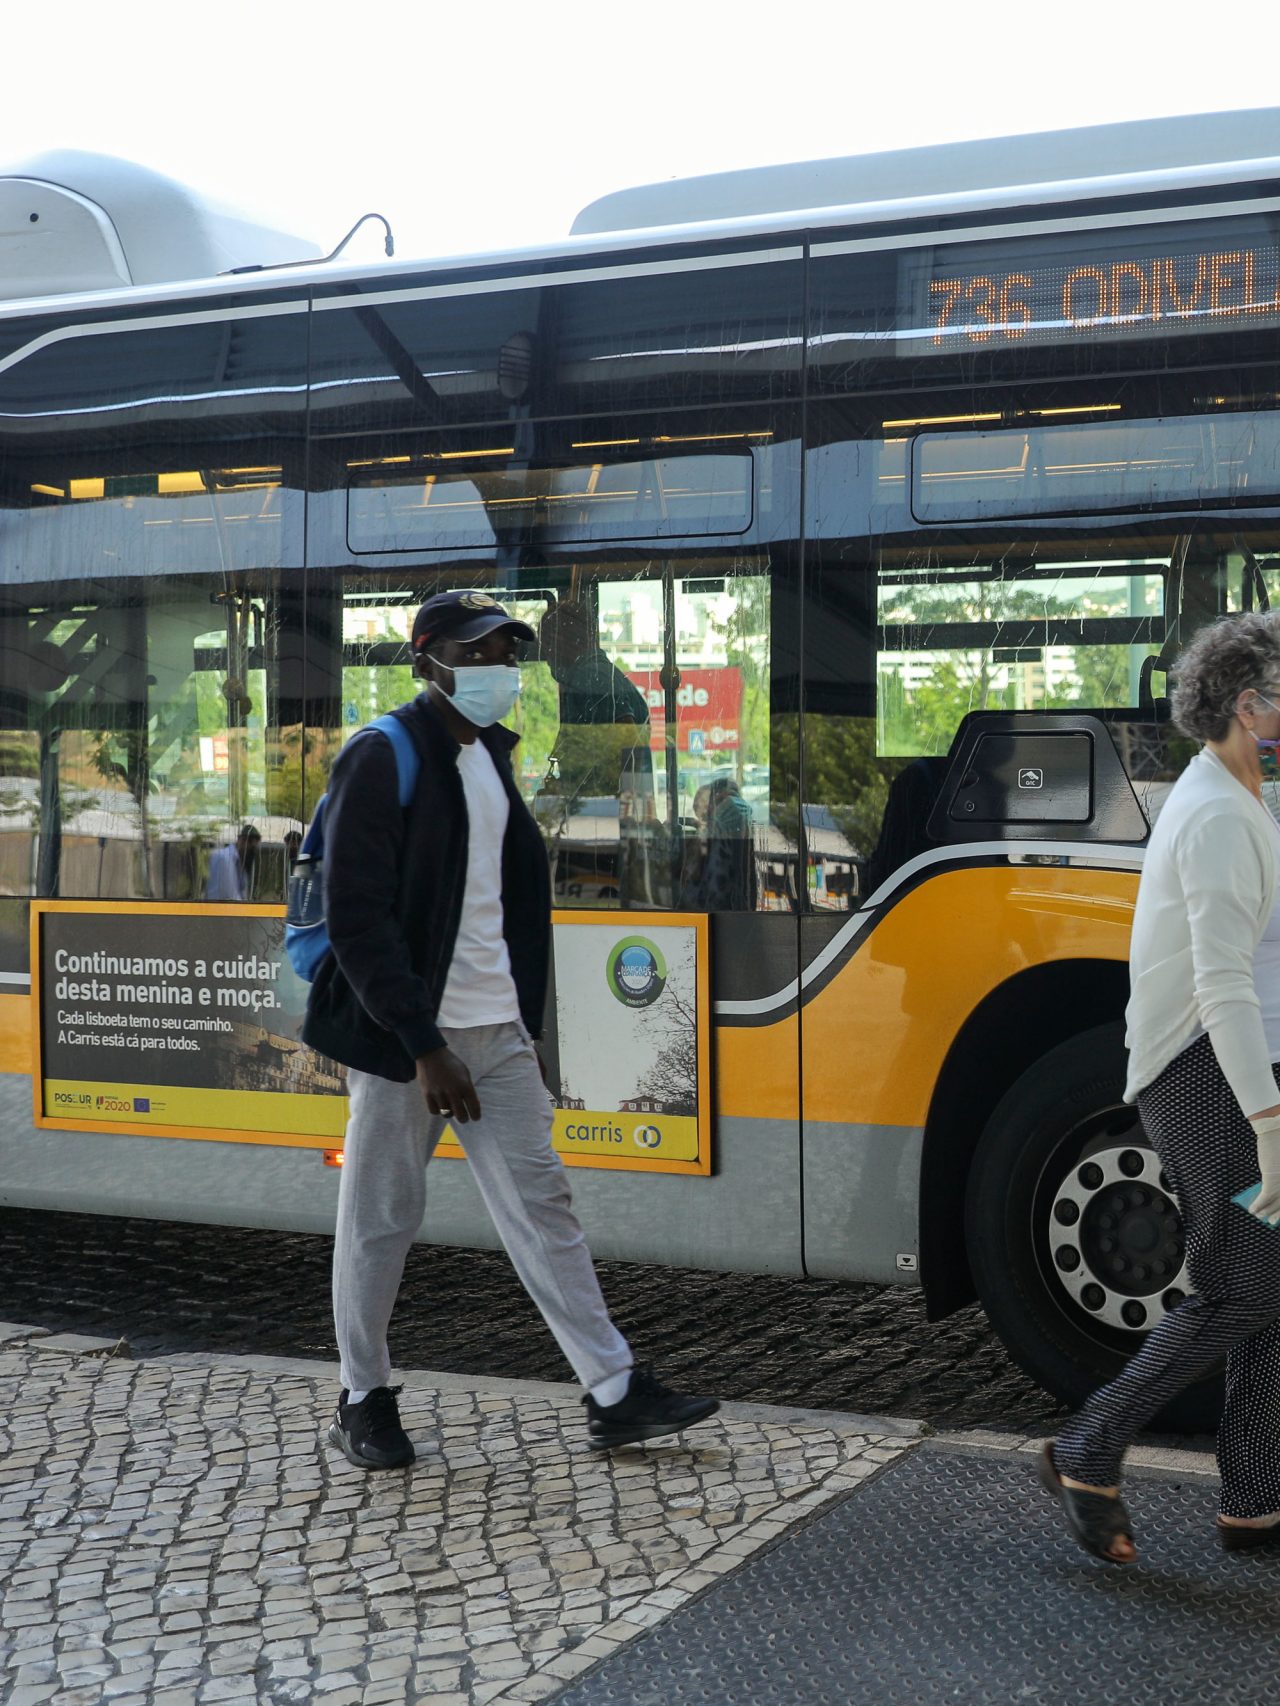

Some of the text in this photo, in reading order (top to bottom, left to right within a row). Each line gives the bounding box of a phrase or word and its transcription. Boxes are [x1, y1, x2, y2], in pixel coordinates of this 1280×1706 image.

[929, 273, 1032, 346] 736
[639, 683, 709, 709] ade
[55, 949, 282, 980] Continuamos a cuidar
[55, 977, 282, 1012] desta menina e moça.
[57, 1010, 234, 1032] Cada lisboeta tem o seu caminho.
[58, 1030, 200, 1052] A Carris está cá para todos.
[105, 1101, 131, 1112] 2020
[565, 1121, 624, 1144] carris
